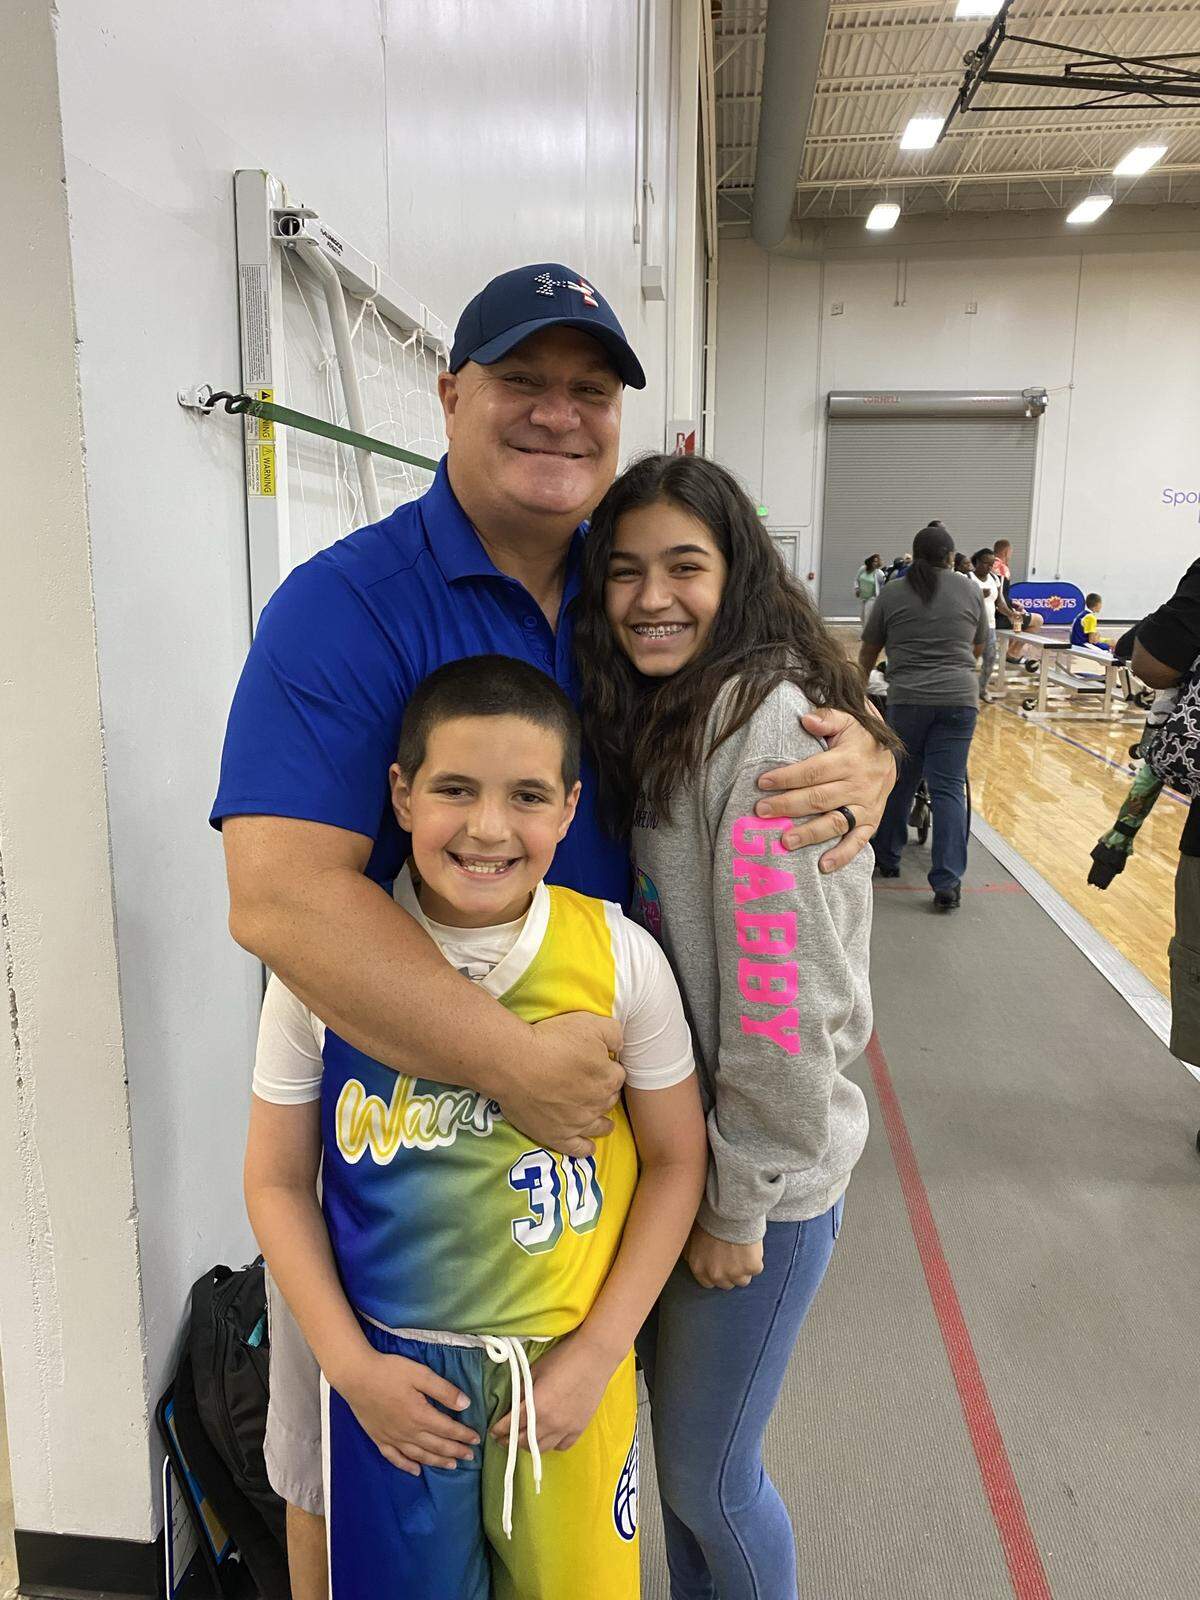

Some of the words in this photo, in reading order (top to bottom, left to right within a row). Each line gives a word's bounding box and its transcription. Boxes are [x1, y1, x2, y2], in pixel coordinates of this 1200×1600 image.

[263, 457, 272, 493] WARNING
[731, 815, 801, 1056] GABBY
[508, 1148, 604, 1256] 30
